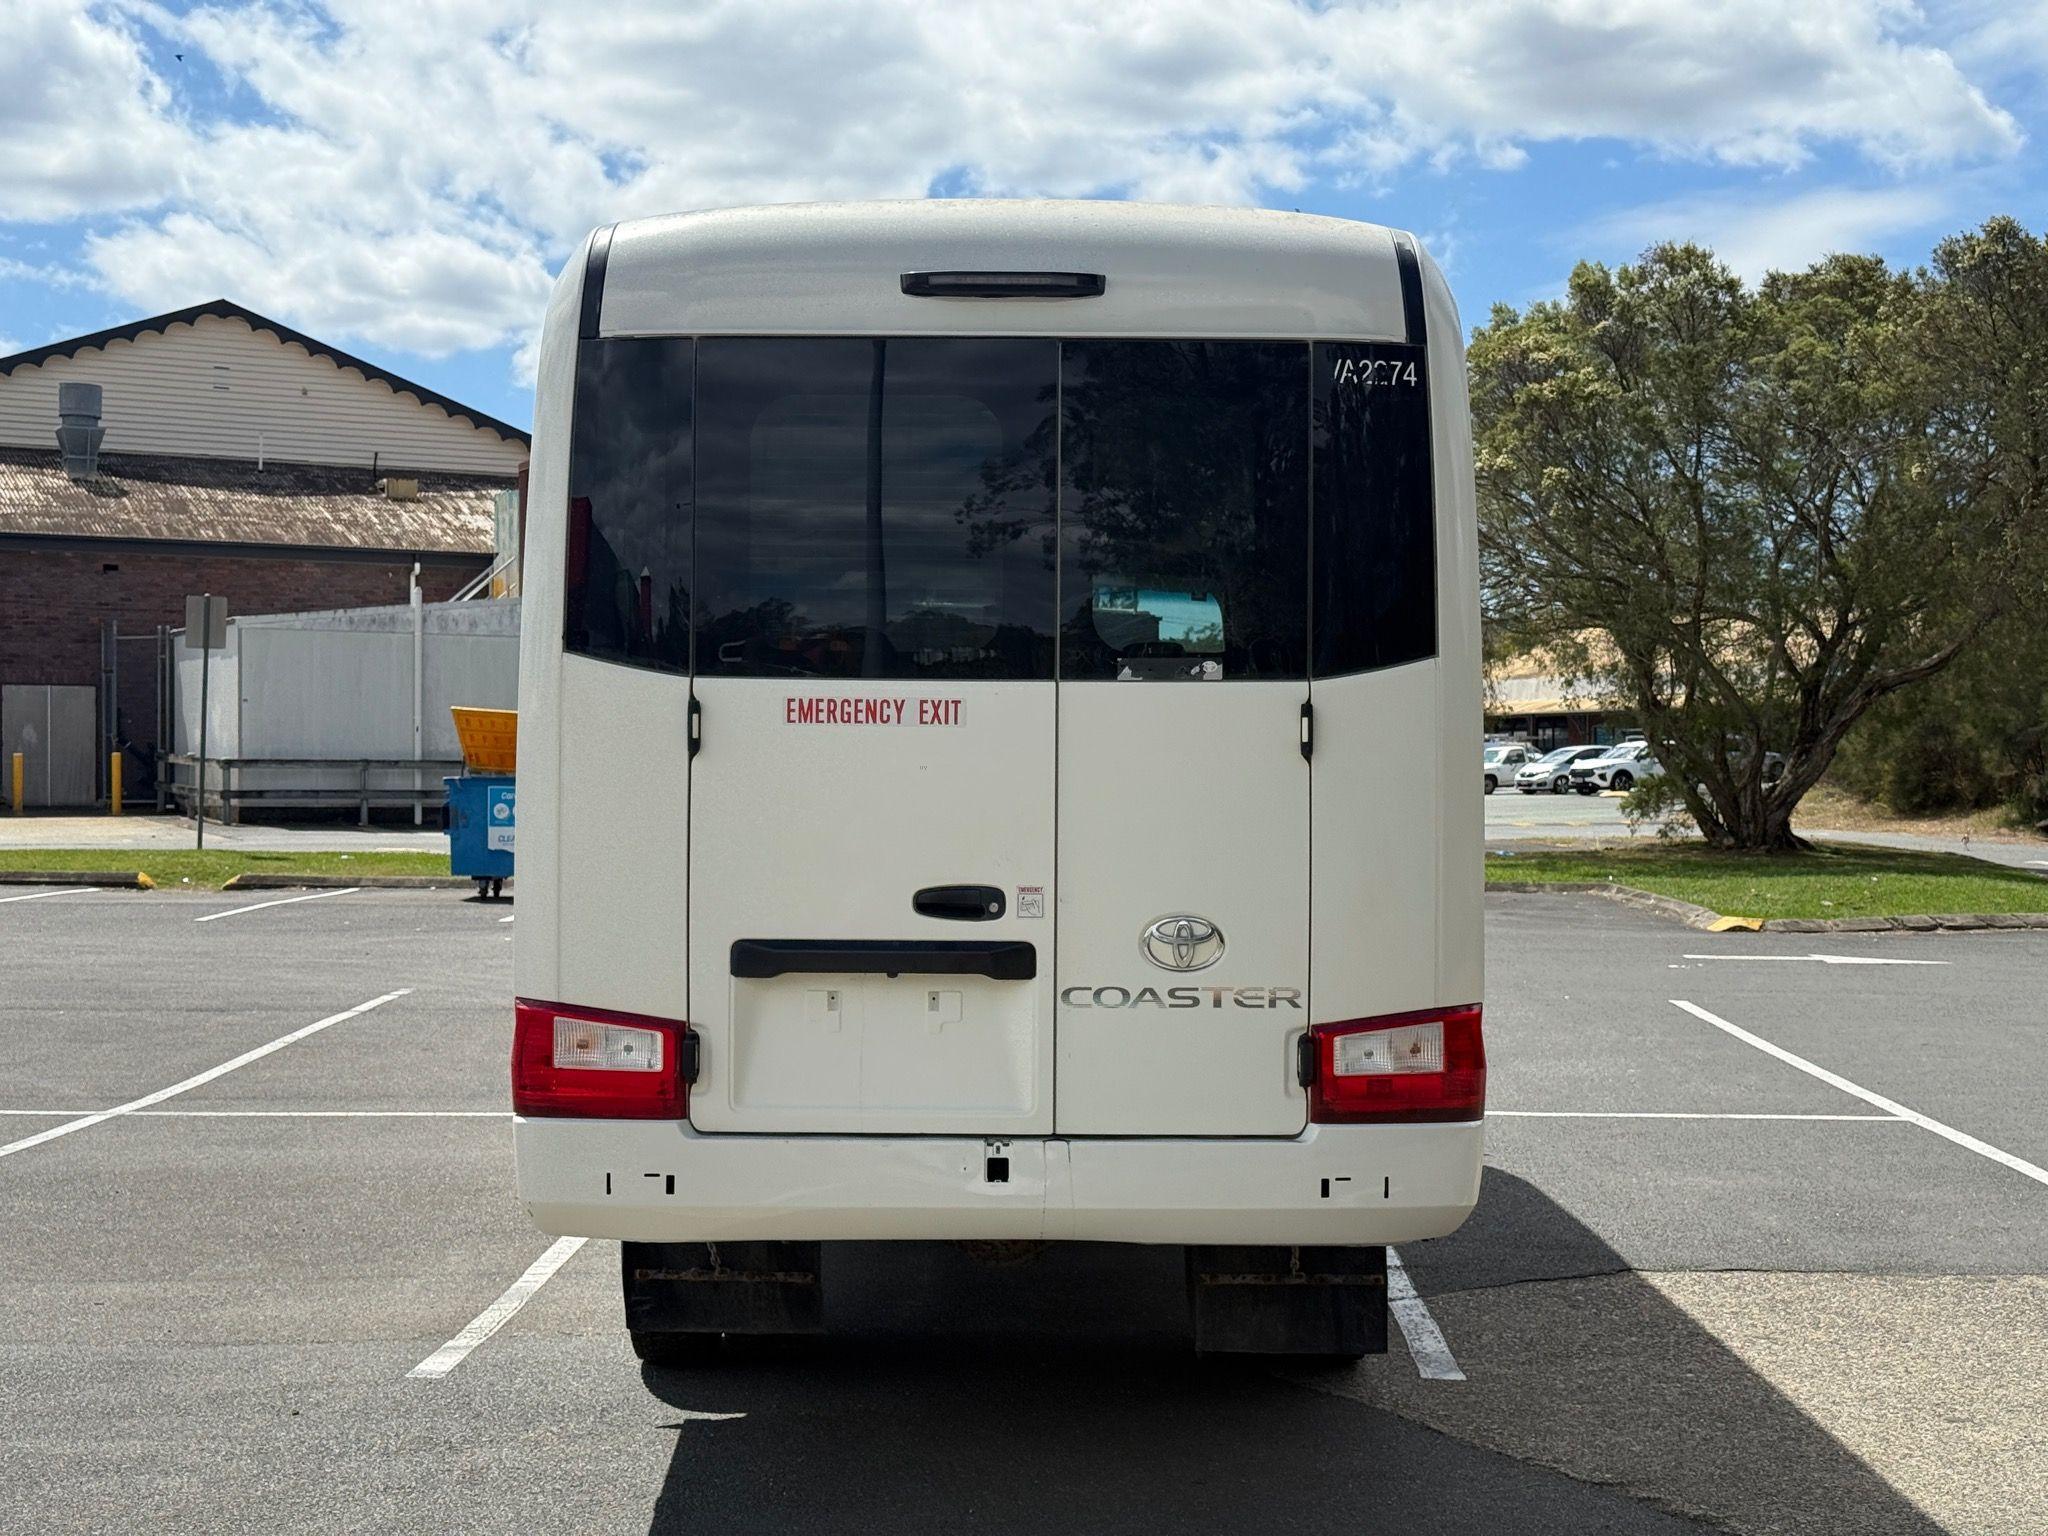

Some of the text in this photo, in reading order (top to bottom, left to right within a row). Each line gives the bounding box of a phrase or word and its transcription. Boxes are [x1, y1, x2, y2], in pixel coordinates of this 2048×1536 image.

[786, 698, 962, 725] EMERGENCY EXIT
[1061, 986, 1303, 1009] COASTER
